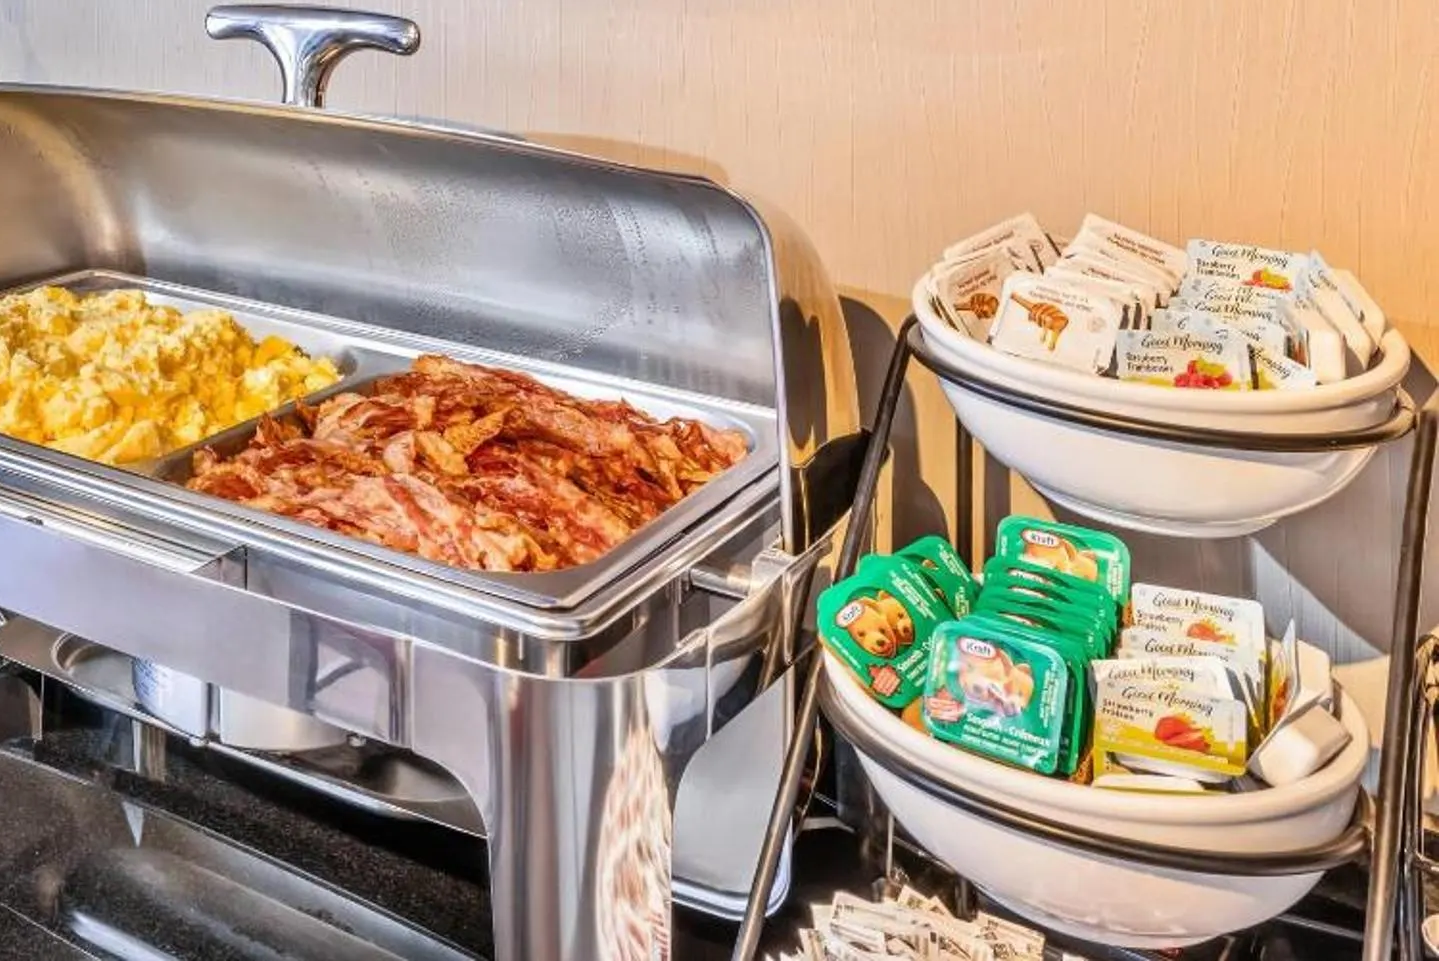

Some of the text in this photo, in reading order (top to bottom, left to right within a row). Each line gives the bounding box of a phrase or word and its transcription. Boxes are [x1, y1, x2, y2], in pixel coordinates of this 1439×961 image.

[1212, 245, 1239, 257] Good
[1141, 334, 1171, 348] Good
[1173, 333, 1224, 355] Morning
[1152, 592, 1235, 621] Good Morning
[965, 642, 992, 655] Kraft
[1144, 638, 1173, 654] Good
[1122, 686, 1213, 716] Good Morning
